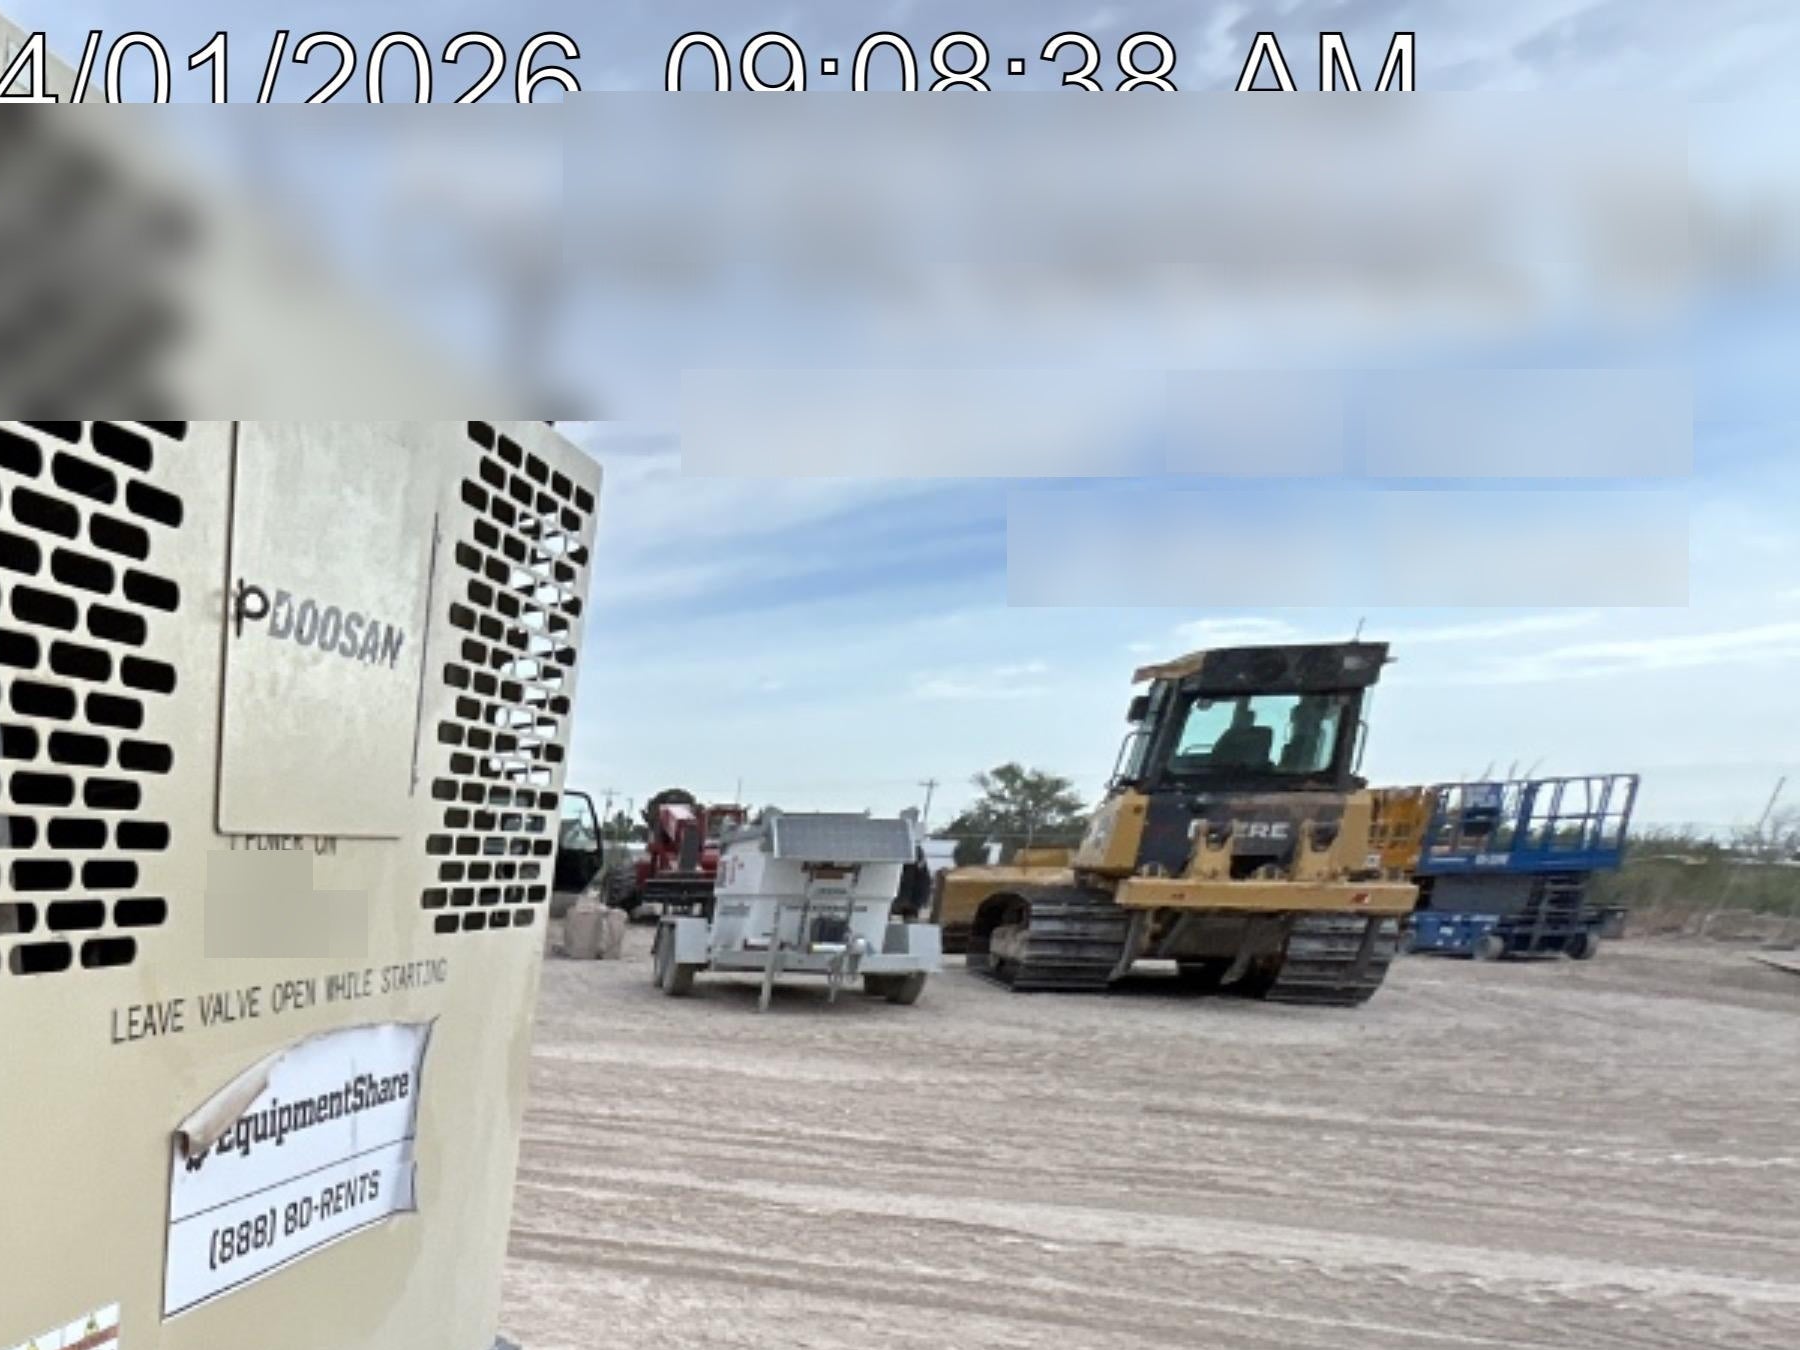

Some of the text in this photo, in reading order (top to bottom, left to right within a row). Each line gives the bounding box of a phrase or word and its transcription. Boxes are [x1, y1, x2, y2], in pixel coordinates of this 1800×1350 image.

[268, 588, 405, 669] DOOSAN
[110, 957, 448, 1045] LEAVE VALVE OPEN WHILE STARTING
[208, 1169, 382, 1270] (888) 80-RENTS
